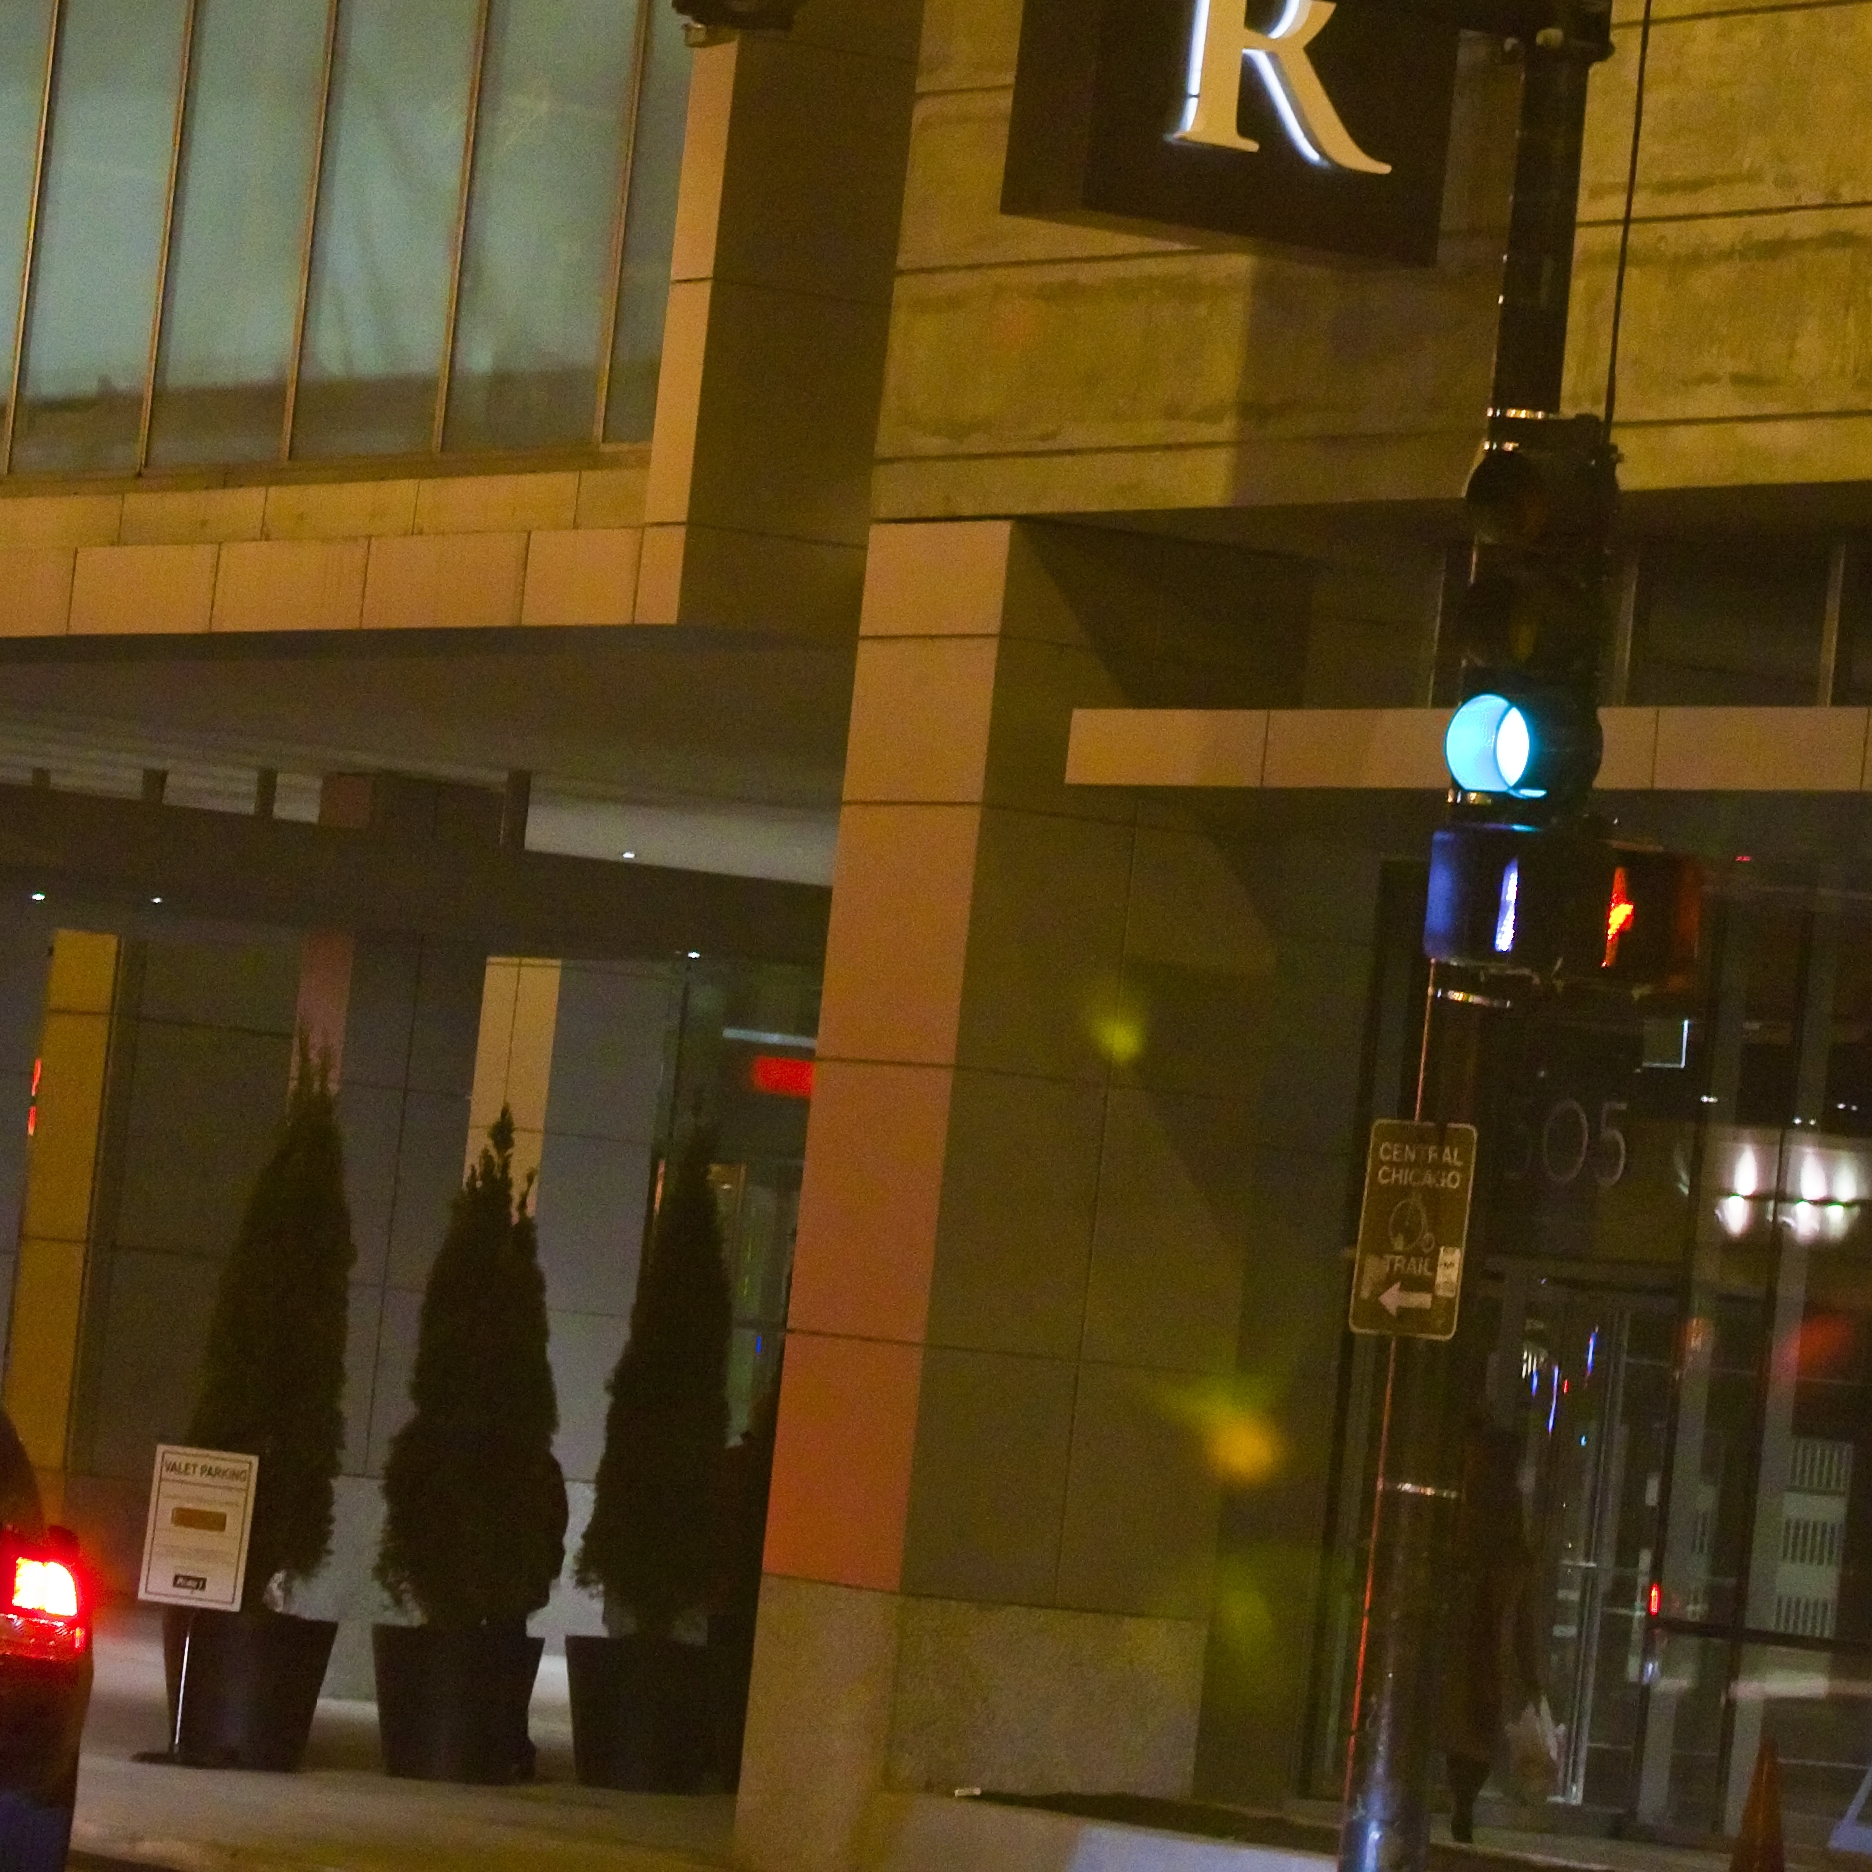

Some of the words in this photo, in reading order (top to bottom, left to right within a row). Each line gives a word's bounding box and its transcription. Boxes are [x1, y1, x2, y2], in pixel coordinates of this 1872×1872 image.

[1378, 1141, 1464, 1167] CENTRAL
[1378, 1166, 1462, 1190] CHICAGO
[1382, 1254, 1435, 1277] TRAIL
[164, 1461, 198, 1474] VALET
[200, 1464, 248, 1482] PARKING
